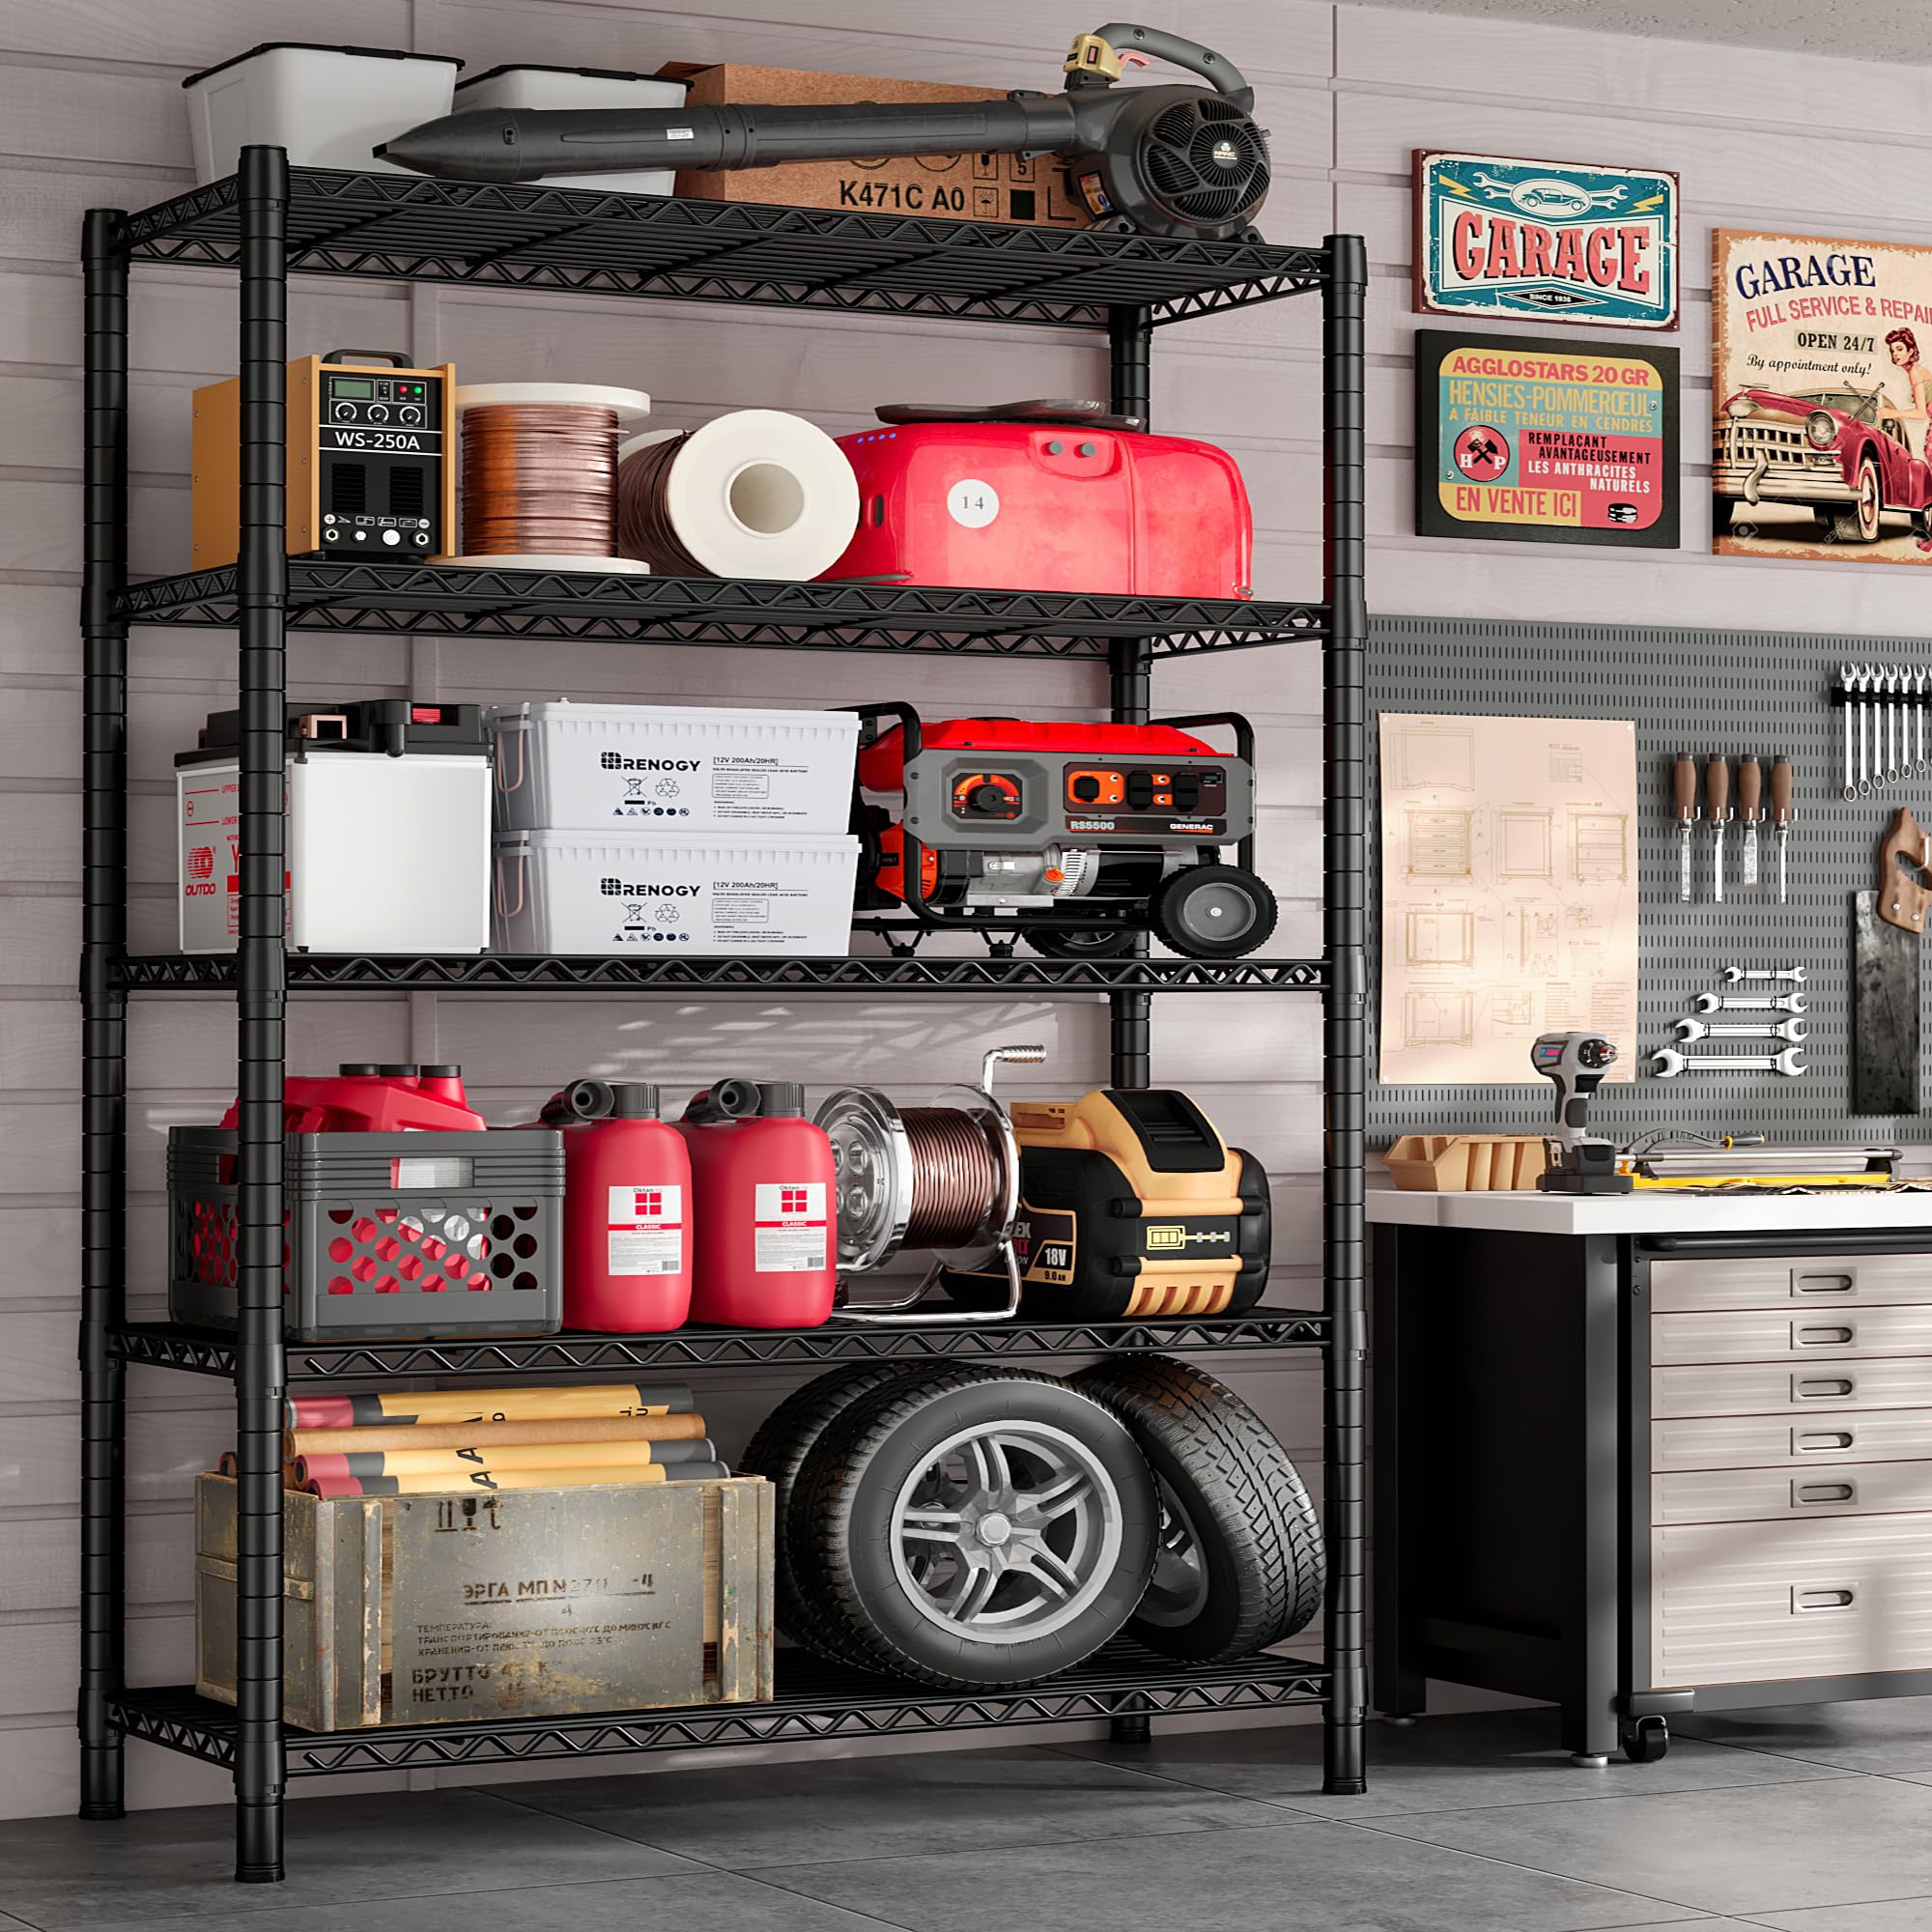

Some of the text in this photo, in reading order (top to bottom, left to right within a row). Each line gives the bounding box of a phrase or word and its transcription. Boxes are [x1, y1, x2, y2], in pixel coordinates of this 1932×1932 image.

[838, 180, 923, 210] K471C
[1453, 211, 1650, 295] GARAGE
[1735, 254, 1876, 299] GARAGE
[1529, 293, 1553, 301] SINCE
[1746, 303, 1787, 332] FULL
[1788, 296, 1861, 321] SERVICE
[1865, 298, 1877, 316] &
[1798, 332, 1875, 352] OPEN 24/7
[1452, 355, 1650, 385] AGGLOSTARS 20 GR
[1747, 355, 1872, 375] By appointment only!
[1449, 408, 1653, 433] A FAIBLE TENEUR EN CENDRES
[334, 431, 421, 450] WS-250A
[1528, 432, 1607, 448] REMPLACANT
[1460, 453, 1473, 469] H
[1493, 456, 1506, 470] P
[1539, 446, 1651, 465] AVANTAGEUSEMENT
[1528, 461, 1636, 479] LES ANTHRACITES
[1590, 478, 1650, 494] NATURELS
[1456, 486, 1577, 518] EN VENTE ICI
[623, 758, 701, 772] RENOGY
[1070, 821, 1115, 830] RS5500
[185, 883, 216, 895] OUTDO
[623, 884, 701, 896] RENOGY
[1045, 1247, 1066, 1266] 18V
[1044, 1270, 1057, 1280] 9.0
[412, 1664, 491, 1684] БРУТТО
[412, 1685, 473, 1702] НЕТТО
